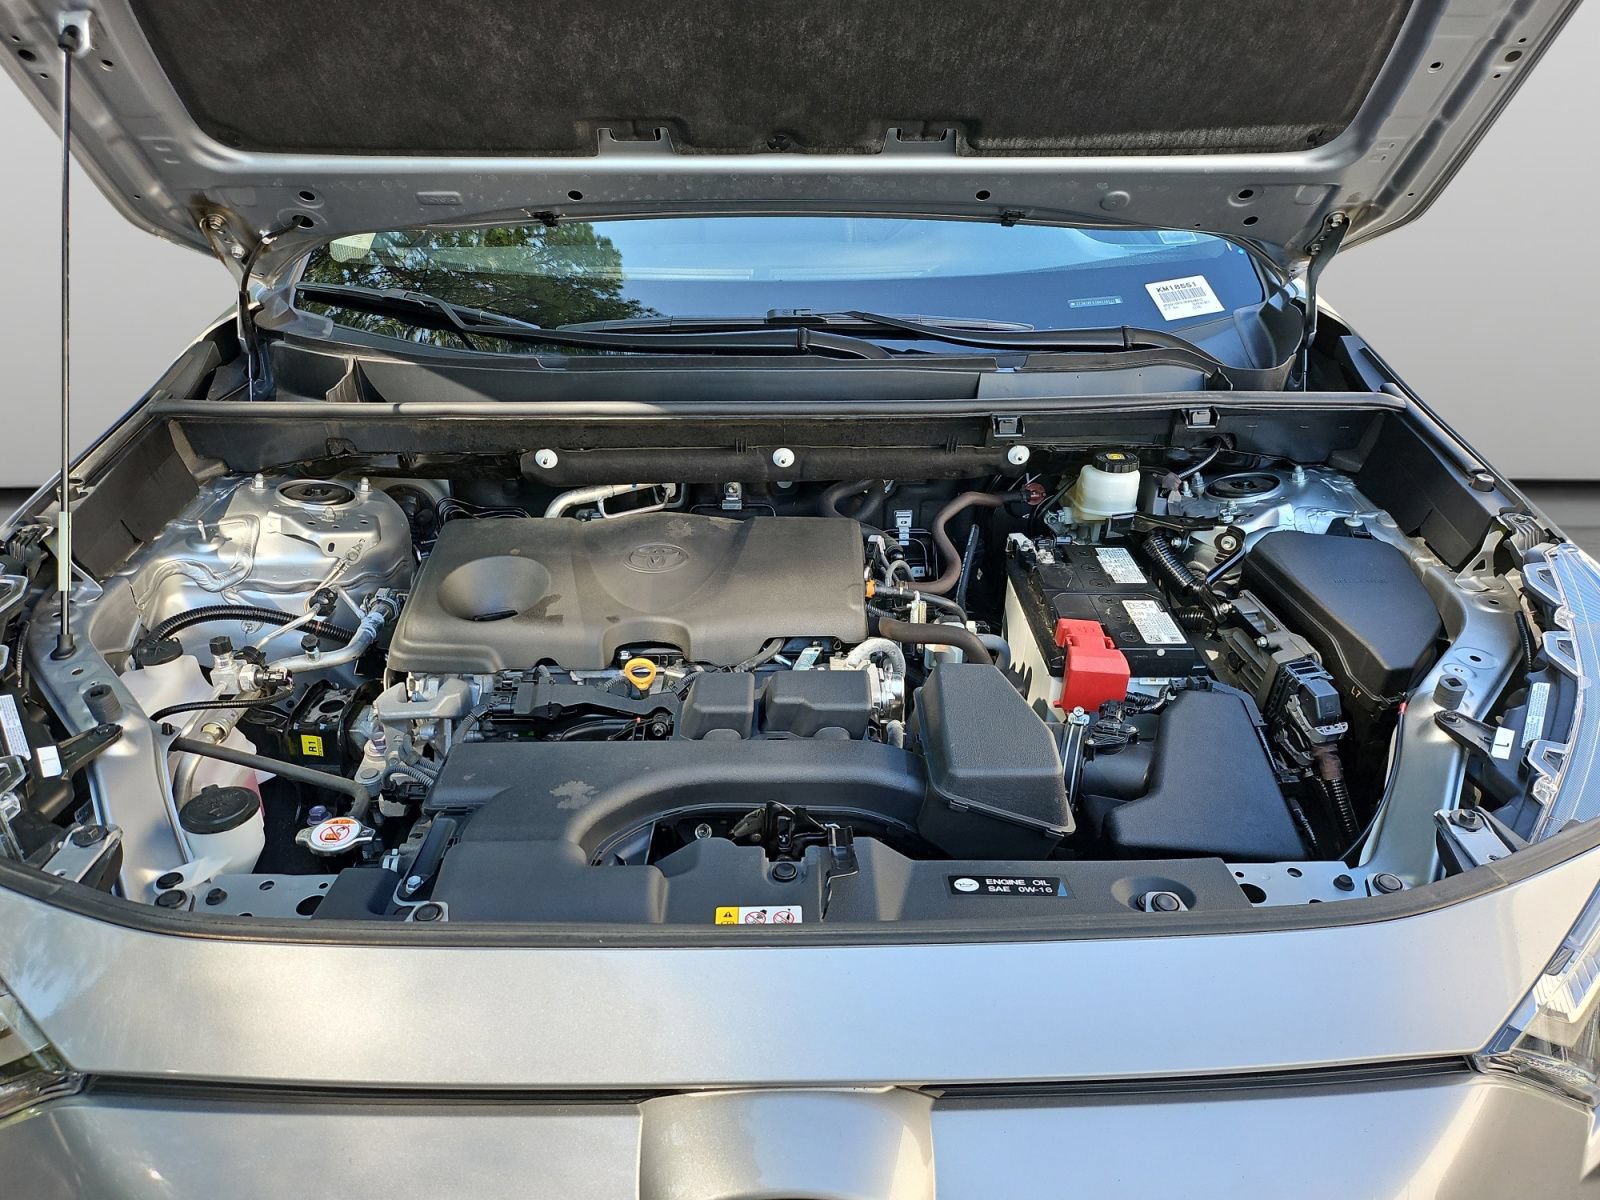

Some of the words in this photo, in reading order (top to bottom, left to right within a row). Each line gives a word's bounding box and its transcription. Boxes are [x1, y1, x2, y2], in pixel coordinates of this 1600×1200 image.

[985, 878, 1026, 886] ENGINE
[1032, 879, 1051, 887] OIL
[988, 885, 1011, 893] SAE
